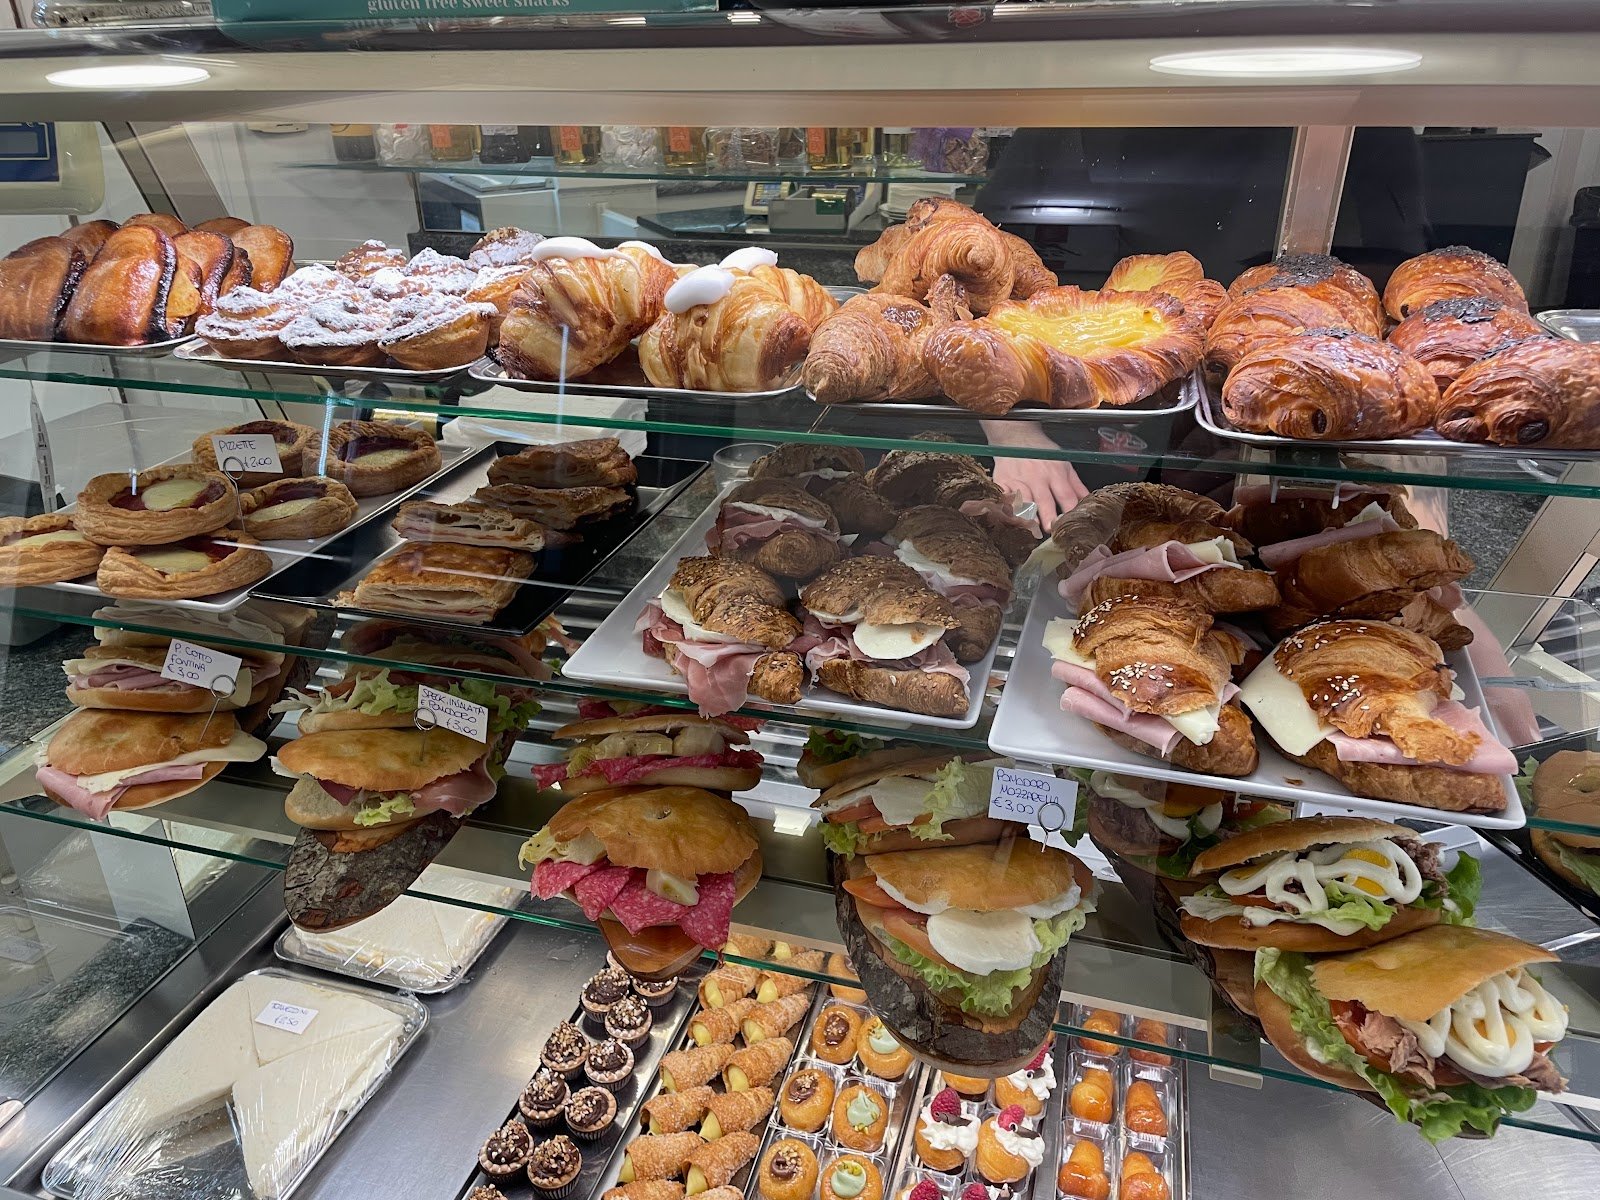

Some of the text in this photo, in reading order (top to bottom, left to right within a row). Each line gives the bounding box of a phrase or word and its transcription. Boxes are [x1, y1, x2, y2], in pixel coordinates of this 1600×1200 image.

[367, 0, 570, 15] gluten free sweet snacks
[218, 439, 257, 453] PIZZETTE
[171, 653, 206, 673] FONTINA
[185, 646, 213, 664] COTTO
[996, 768, 1051, 792] POMODORO
[999, 784, 1059, 803] MOZZARELLA
